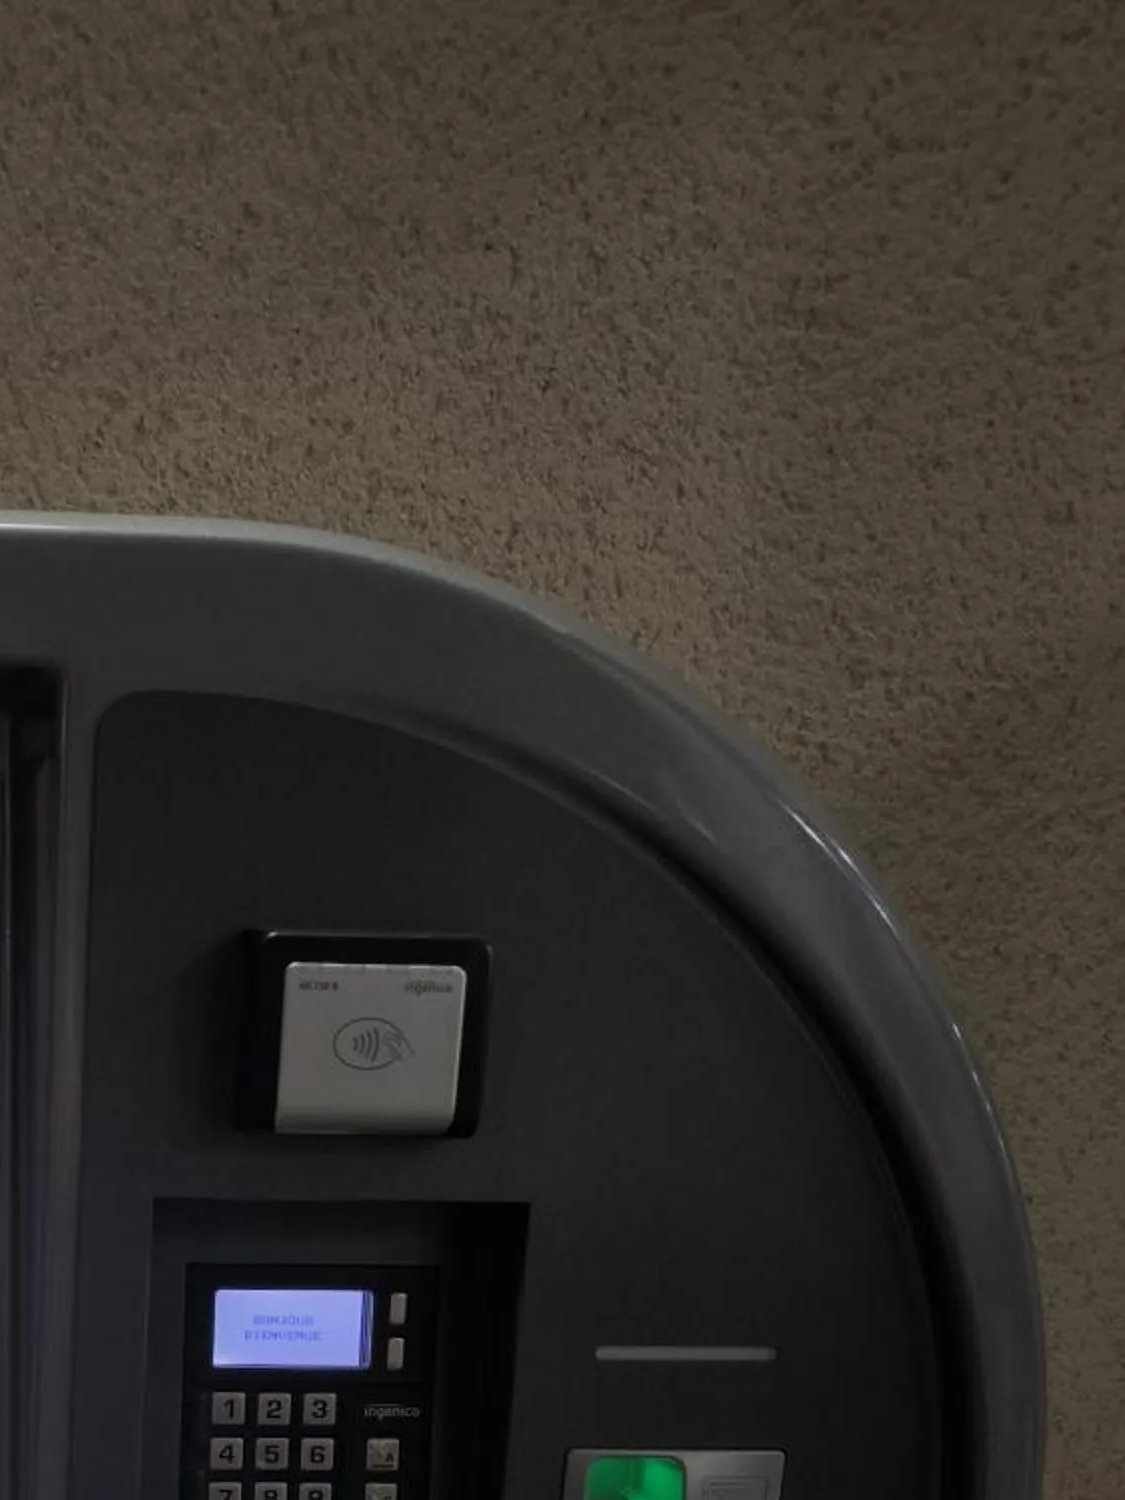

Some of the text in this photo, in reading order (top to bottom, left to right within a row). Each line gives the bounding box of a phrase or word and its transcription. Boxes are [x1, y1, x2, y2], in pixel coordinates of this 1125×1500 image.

[224, 1399, 328, 1420] 1 2 3
[364, 1405, 421, 1420] ingenico
[218, 1444, 325, 1464] 4 5 6
